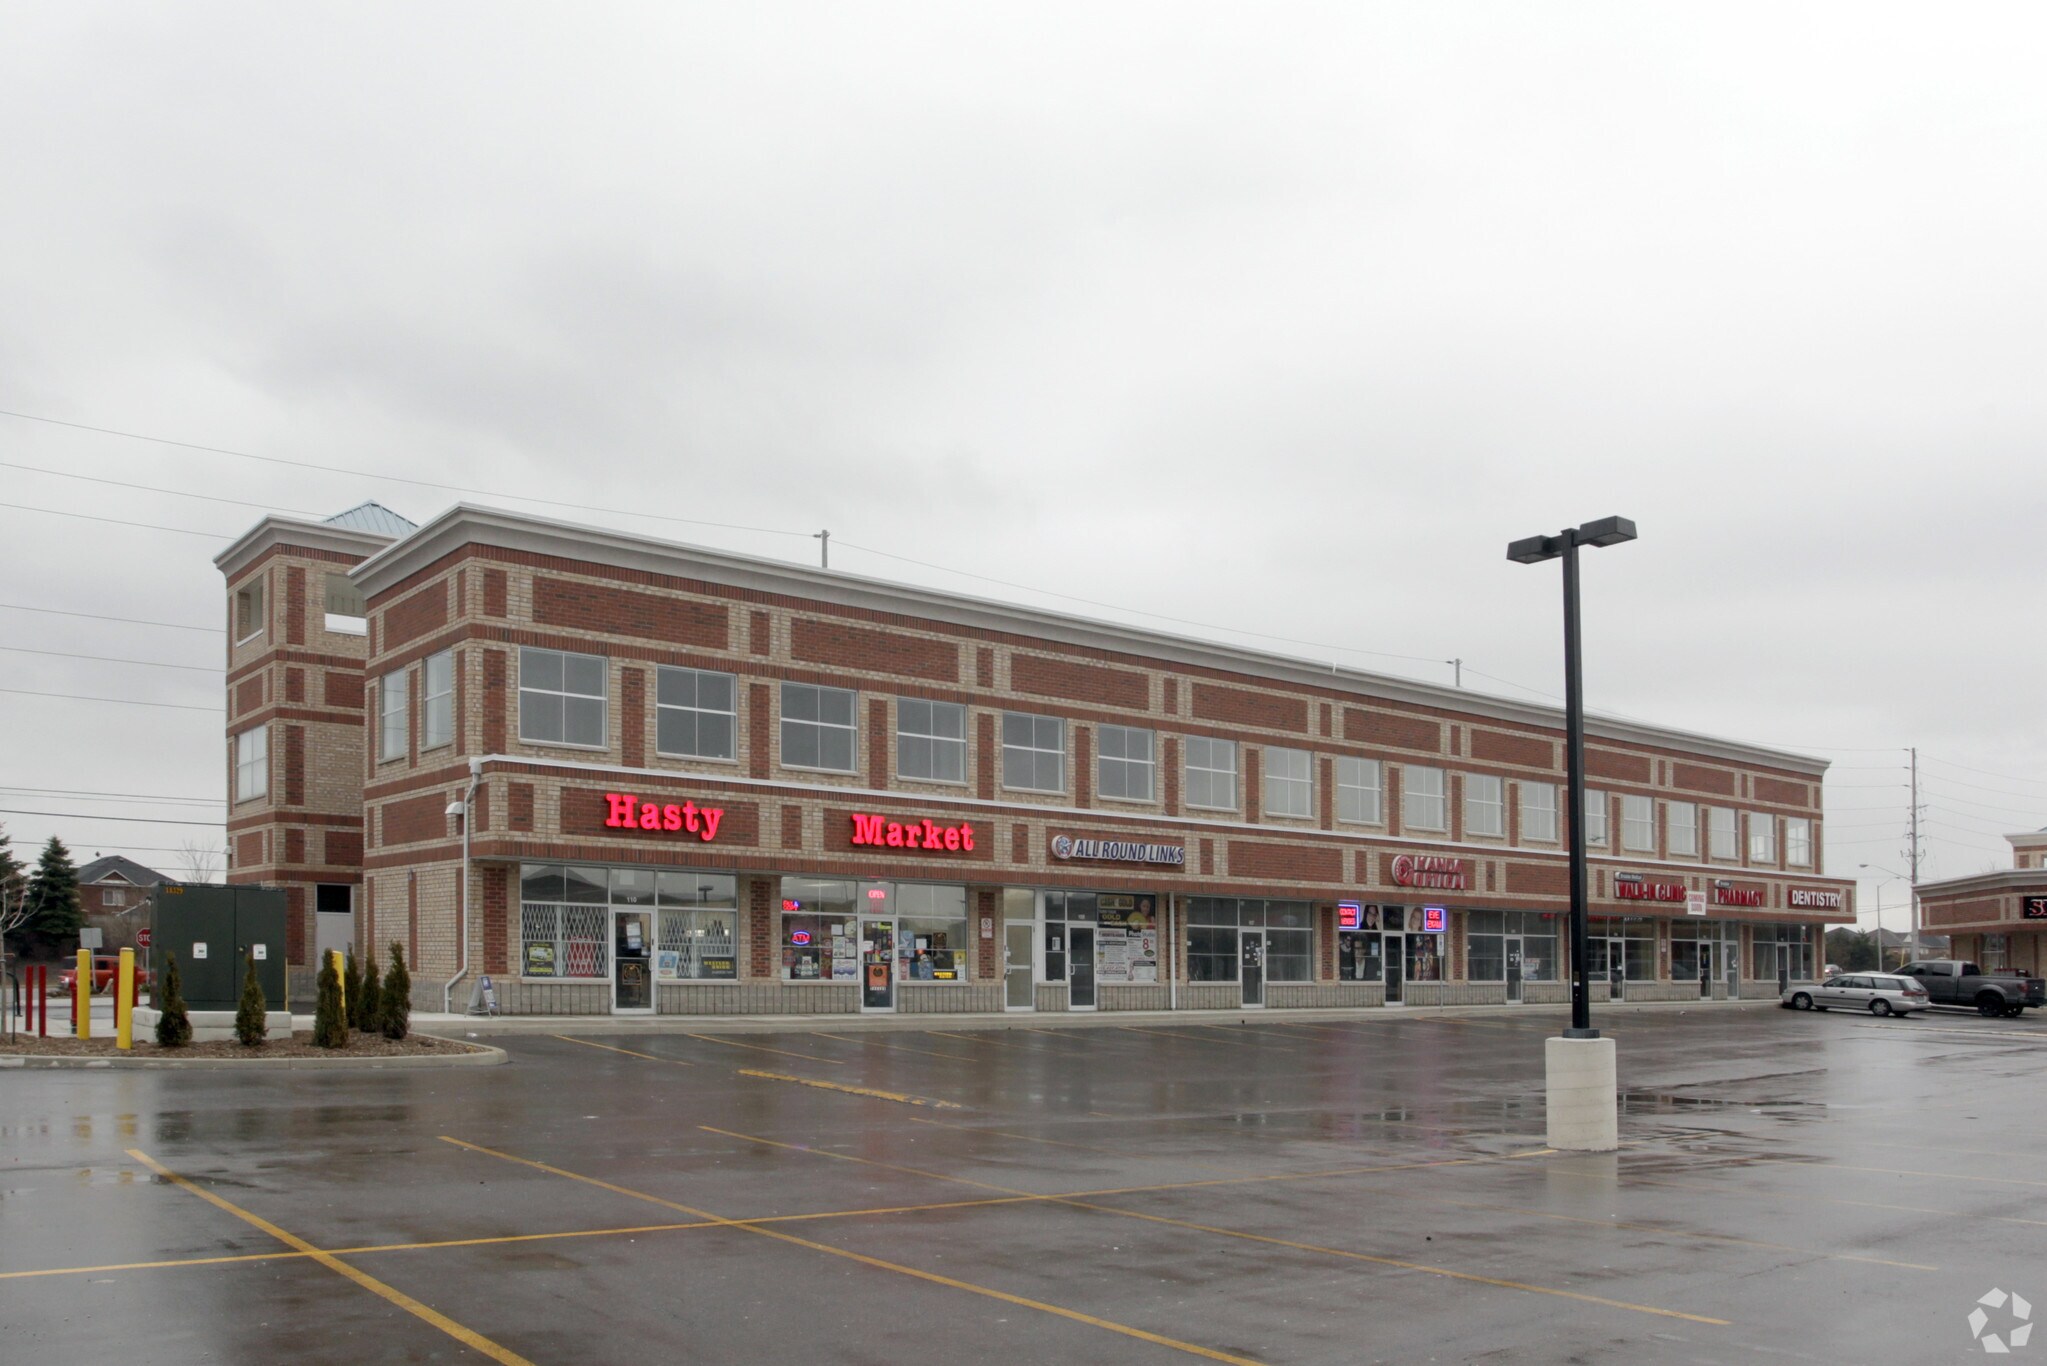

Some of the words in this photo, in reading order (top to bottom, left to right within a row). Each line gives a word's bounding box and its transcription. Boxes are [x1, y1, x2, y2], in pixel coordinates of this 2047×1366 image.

[604, 793, 724, 841] Hasty
[851, 813, 975, 851] Market
[1075, 840, 1099, 857] ALL
[1101, 841, 1146, 861] ROUND
[1149, 844, 1184, 863] LINKS
[867, 889, 886, 899] OPEN
[1655, 884, 1687, 902] CLINIC
[1714, 888, 1764, 906] PHARMACY
[1791, 889, 1841, 907] DENTISTRY
[1428, 910, 1440, 919] EYE
[138, 934, 150, 942] STO
[791, 933, 811, 942] ATM
